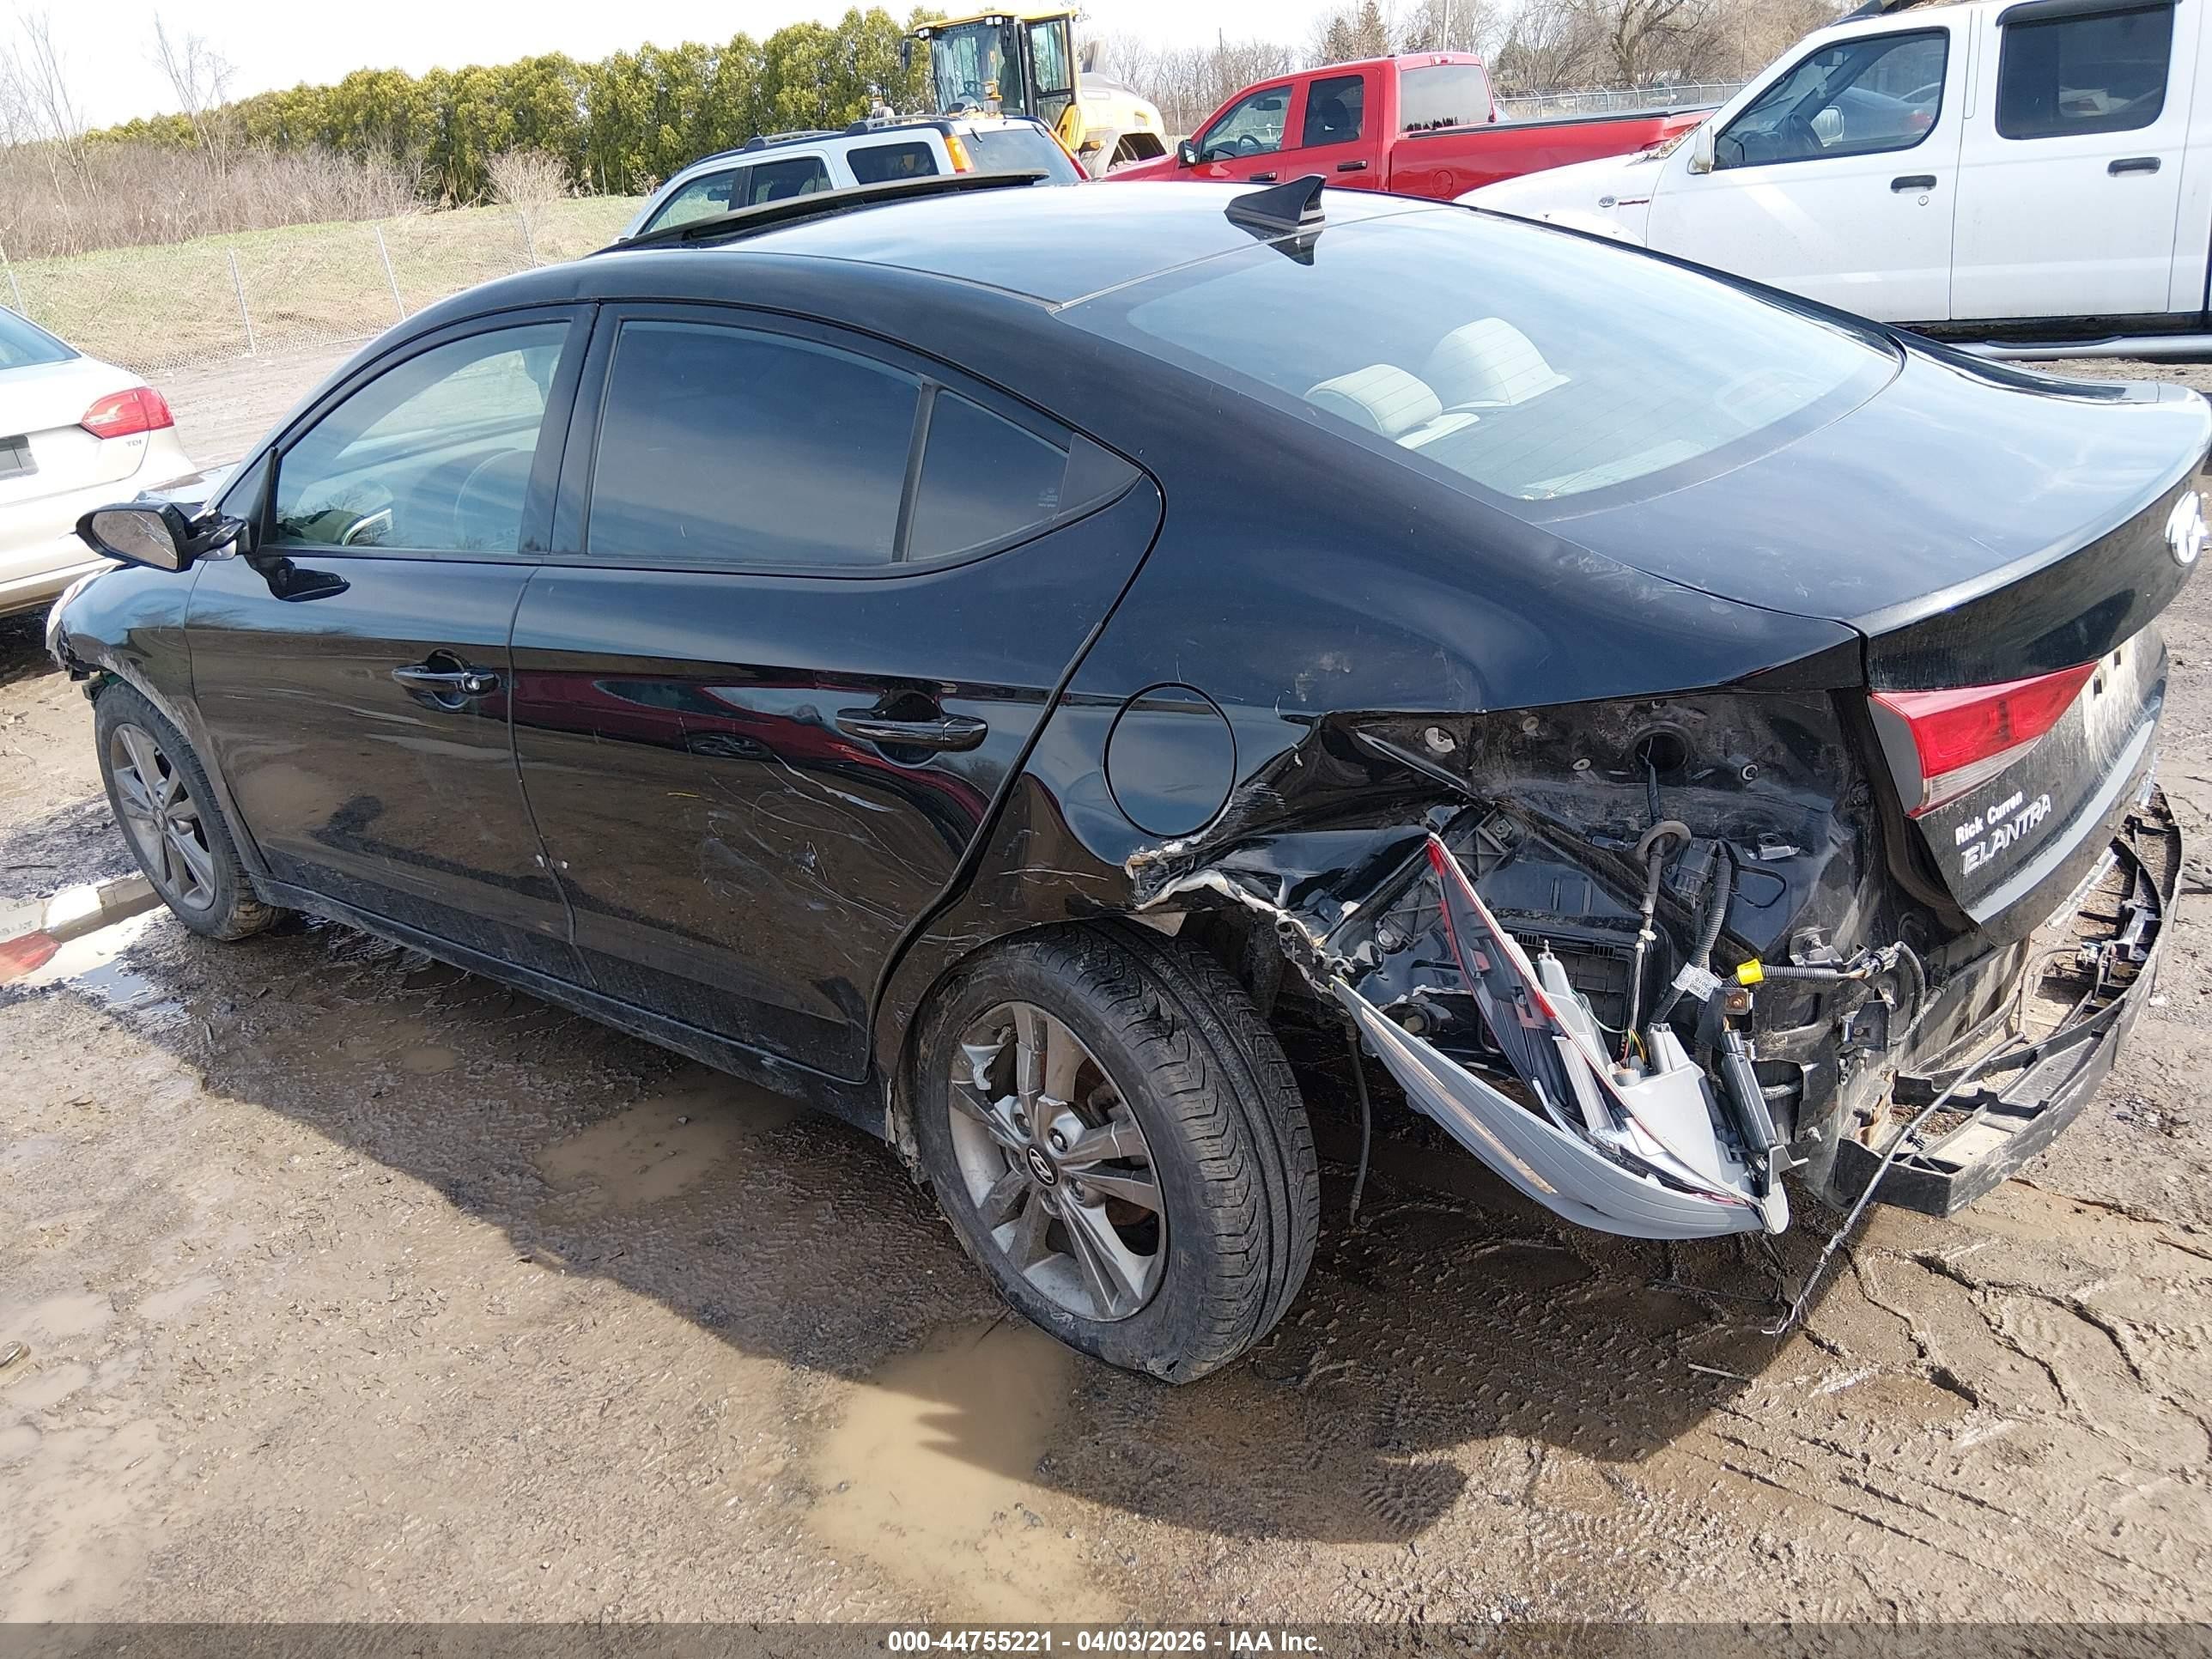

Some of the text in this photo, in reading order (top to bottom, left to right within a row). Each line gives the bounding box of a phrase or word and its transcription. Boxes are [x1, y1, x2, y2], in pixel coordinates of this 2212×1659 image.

[125, 439, 142, 447] TDI
[1955, 816, 1984, 846] Rick
[1960, 793, 2051, 876] ELANTRA
